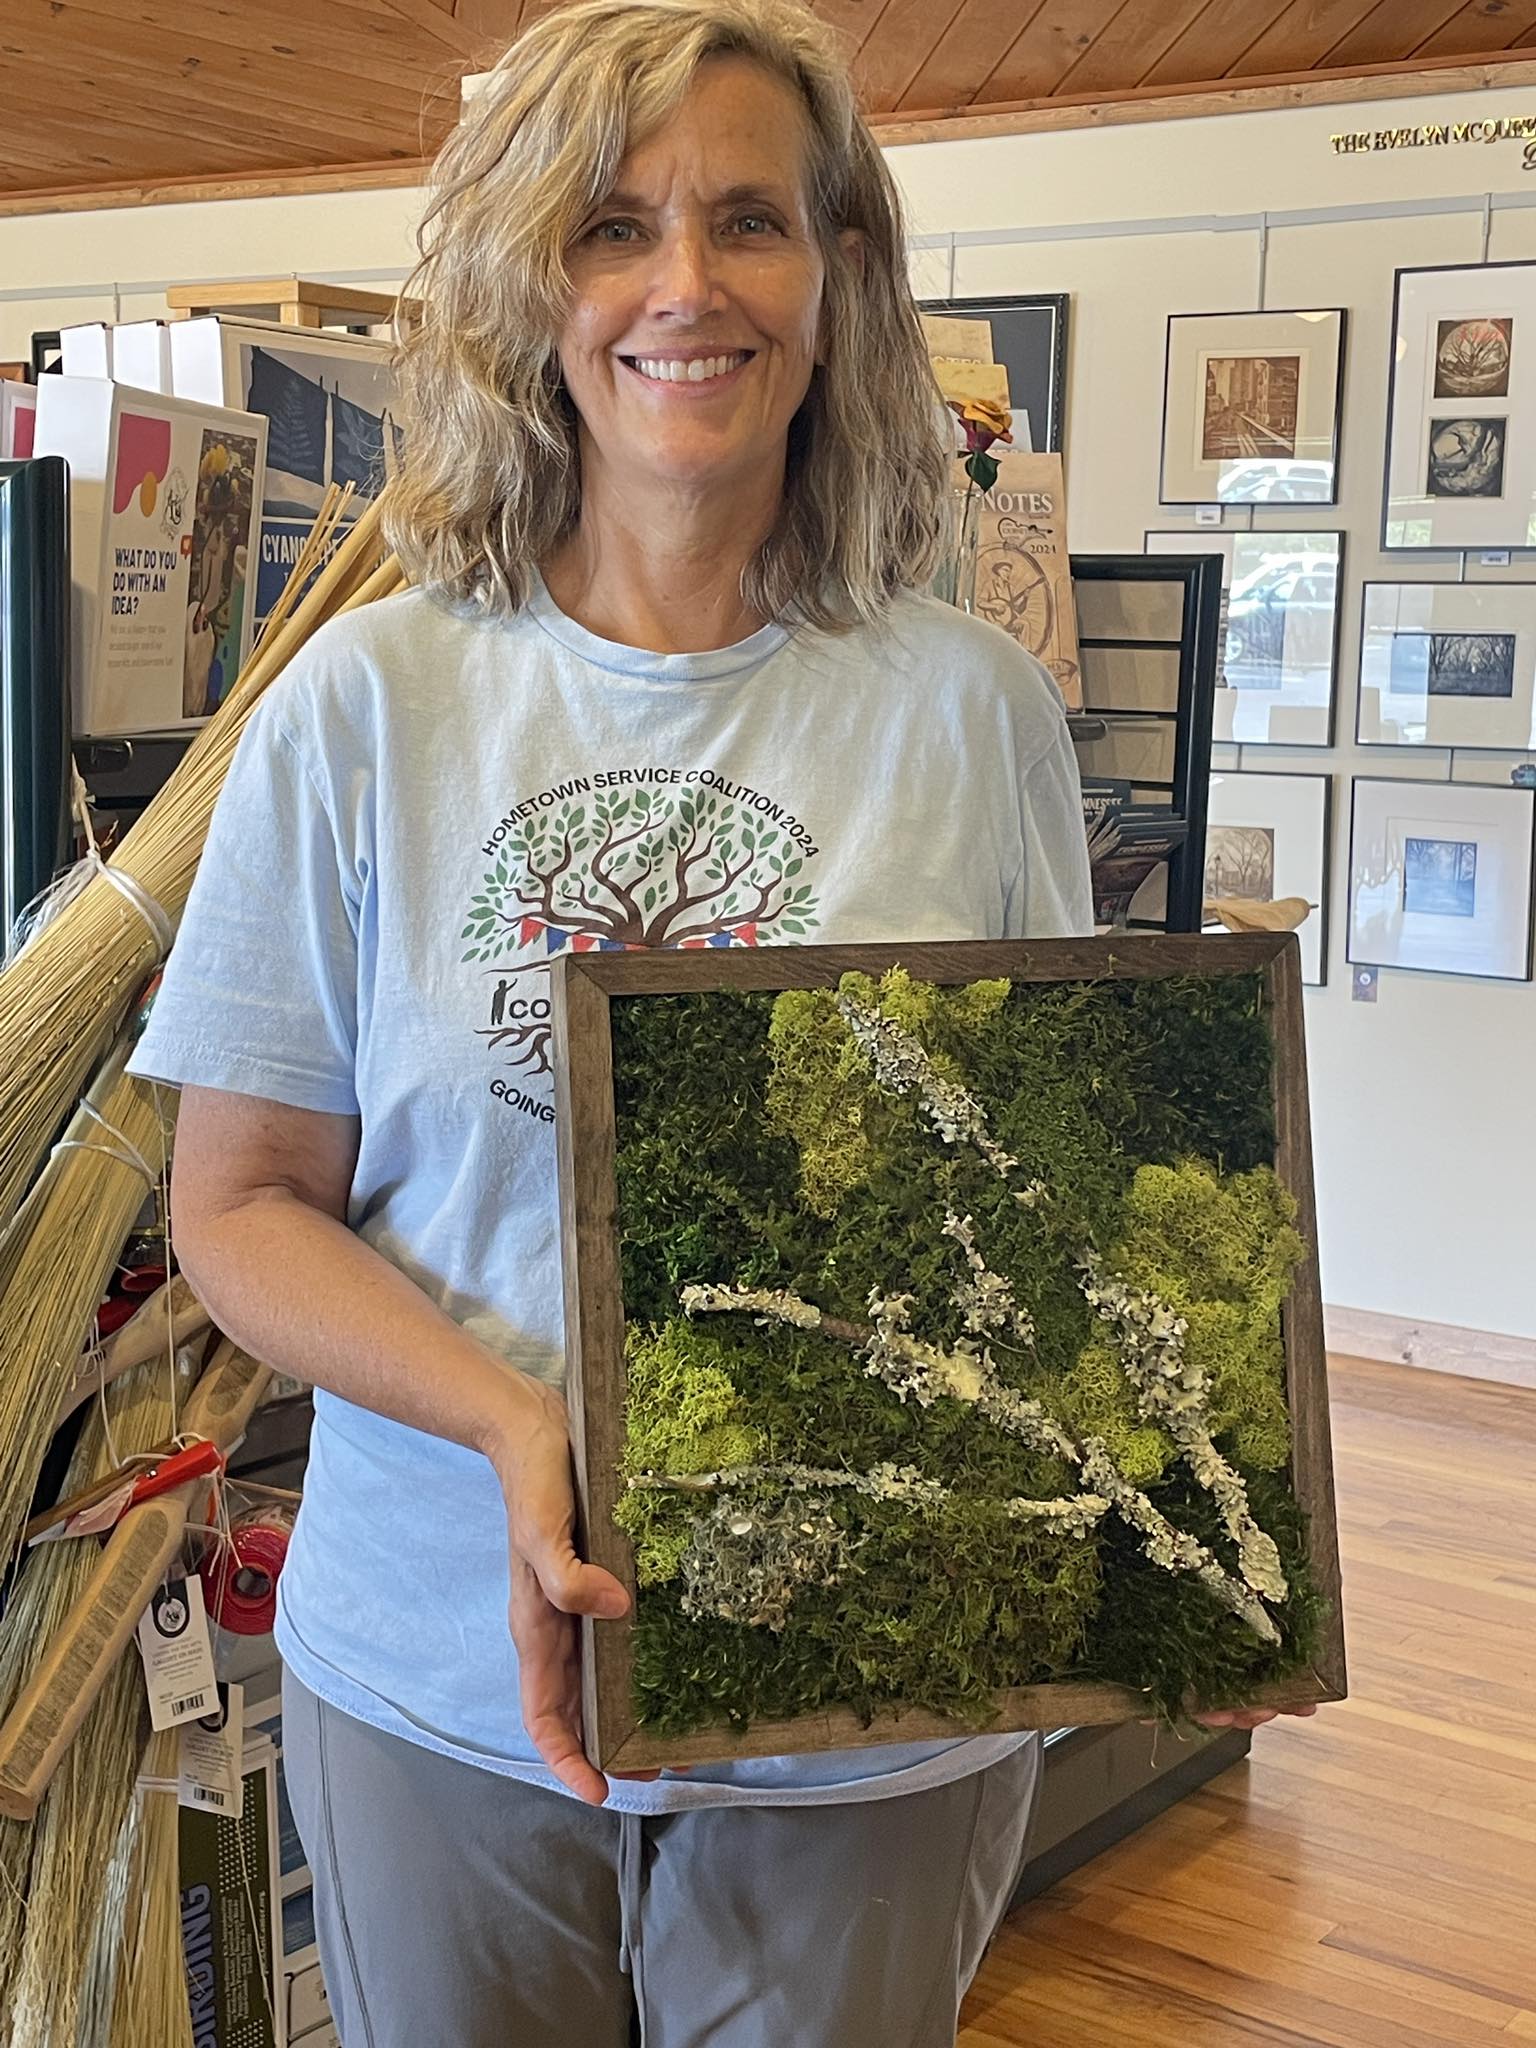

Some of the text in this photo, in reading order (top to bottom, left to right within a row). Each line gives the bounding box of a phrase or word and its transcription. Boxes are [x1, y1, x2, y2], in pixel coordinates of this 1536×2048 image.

[1330, 132, 1370, 155] THE
[1373, 125, 1449, 151] EVELYN
[981, 489, 1053, 513] NOTES
[115, 548, 177, 570] WHAT DO YOU
[113, 572, 166, 592] DO WITH AN
[111, 596, 139, 615] IDEA?
[482, 768, 819, 858] HOMETOWN SERVICE COALITION 2024
[489, 1079, 556, 1124] GOING
